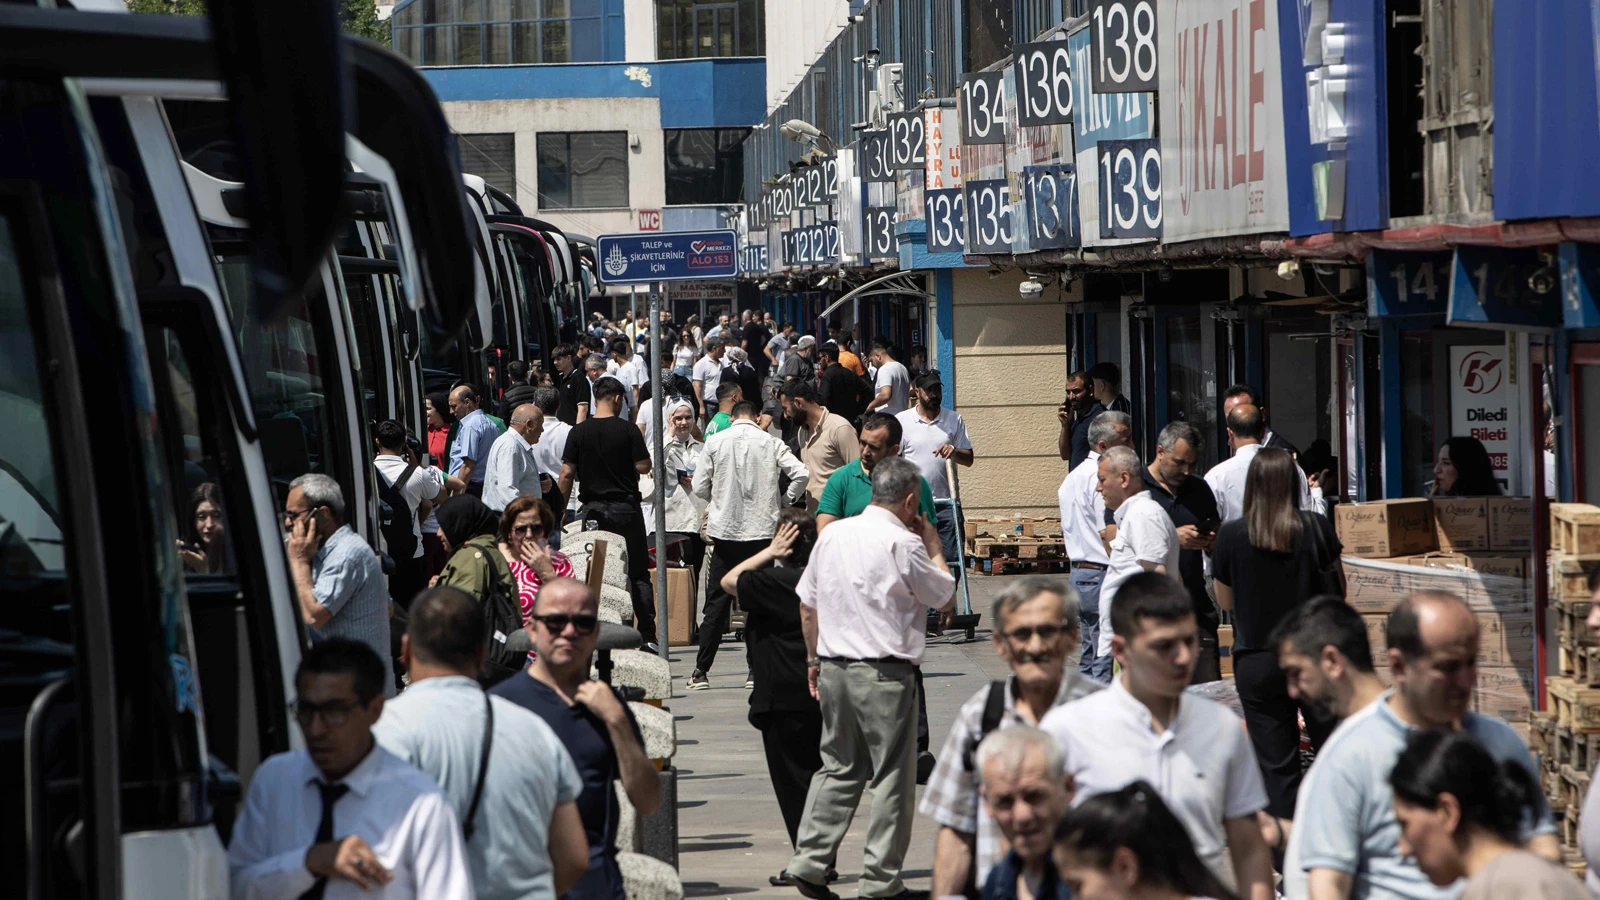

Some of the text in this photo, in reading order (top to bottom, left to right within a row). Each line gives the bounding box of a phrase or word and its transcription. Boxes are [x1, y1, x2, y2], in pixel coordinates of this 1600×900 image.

[1093, 1, 1157, 83] 138
[1018, 48, 1073, 118] 136
[963, 79, 1007, 138] 134
[889, 117, 924, 164] 132
[772, 188, 791, 216] 120
[1101, 148, 1163, 230] 139
[640, 212, 659, 229] WC
[926, 194, 964, 247] 133
[970, 187, 1012, 246] 135
[630, 250, 685, 263] ŞİKAYETLERİNİZ
[641, 241, 662, 250] TALEP
[650, 262, 666, 274] İÇİN
[691, 255, 729, 265] ALO 153
